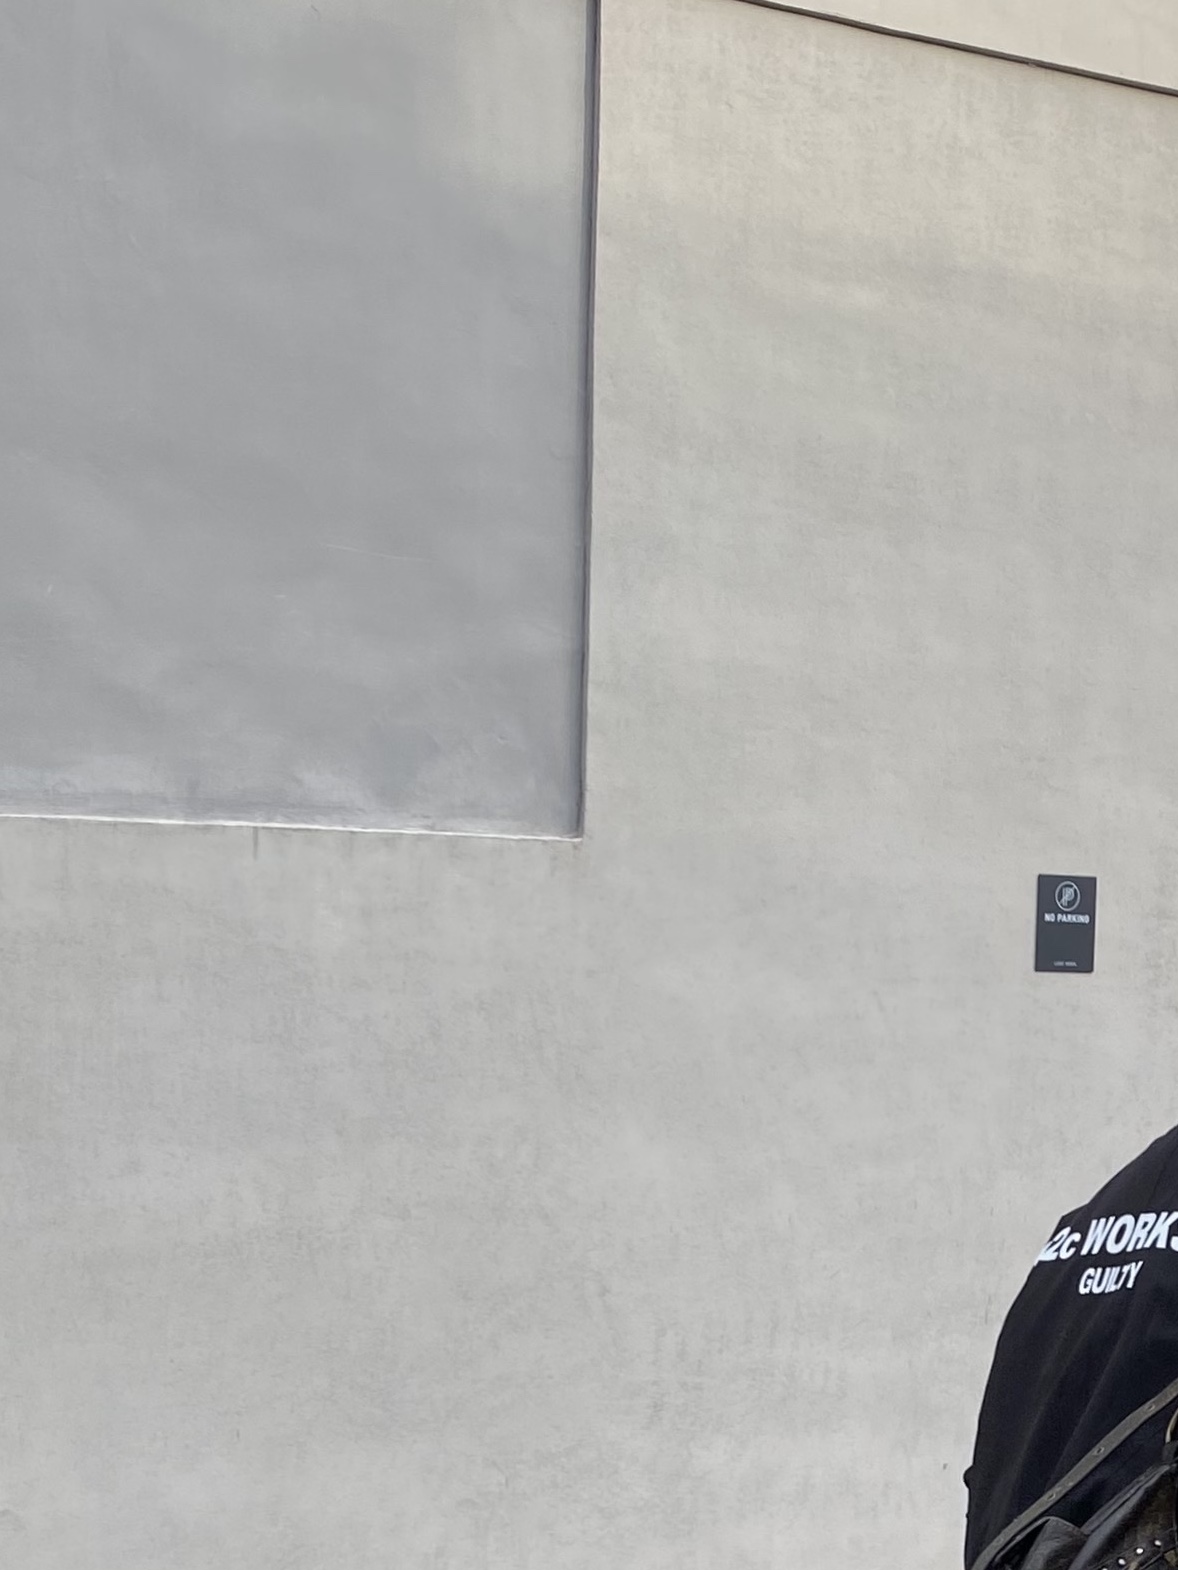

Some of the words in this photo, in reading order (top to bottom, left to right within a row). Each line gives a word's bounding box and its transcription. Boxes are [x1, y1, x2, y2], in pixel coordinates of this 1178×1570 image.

[1044, 912, 1056, 922] NO
[1057, 913, 1090, 924] PARKING
[1079, 1260, 1144, 1295] GUILTY
